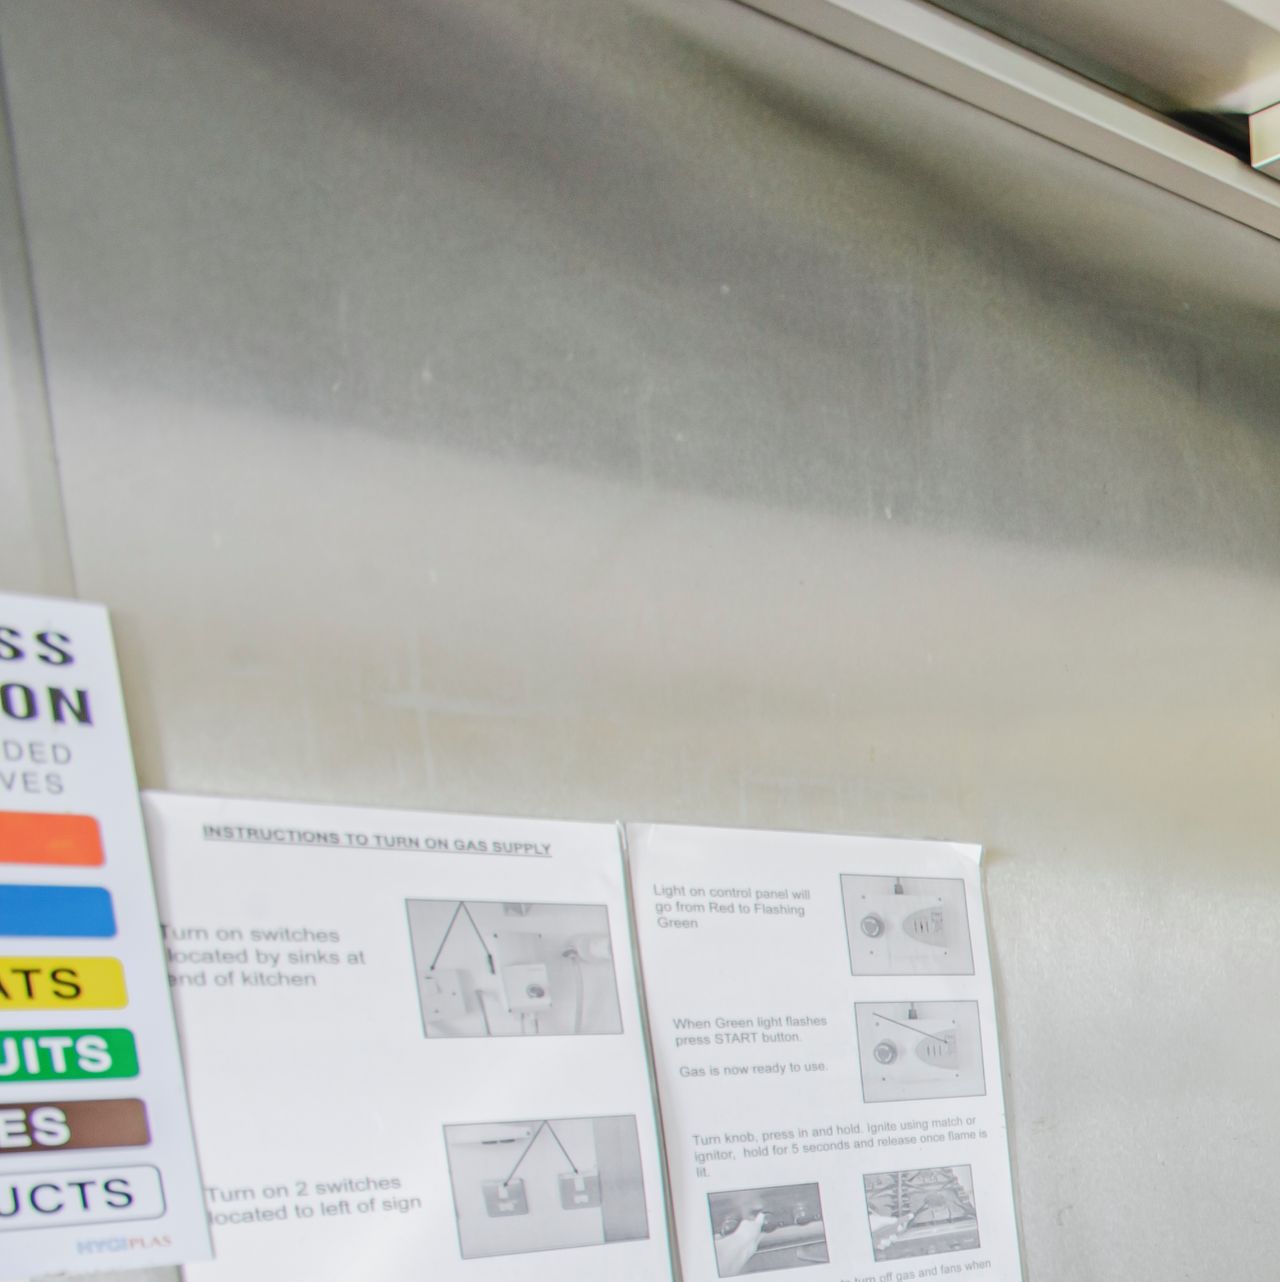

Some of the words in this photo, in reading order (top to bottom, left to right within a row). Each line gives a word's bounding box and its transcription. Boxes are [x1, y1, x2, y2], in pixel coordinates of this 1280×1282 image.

[203, 824, 340, 845] INSTRUCTIONS
[345, 833, 369, 846] TO
[374, 834, 420, 849] TURN
[425, 837, 450, 850] ON
[454, 839, 489, 852] GAS
[493, 841, 552, 856] SUPPLY
[652, 884, 686, 899] Light
[688, 887, 706, 897] on
[708, 887, 752, 898] control
[754, 888, 789, 900] panel
[791, 888, 811, 900] will
[654, 902, 672, 915] go
[675, 900, 705, 912] from
[708, 900, 735, 914] Red
[737, 902, 751, 914] to
[753, 902, 805, 917] Flashing
[656, 916, 699, 928] Green
[215, 927, 244, 941] on
[249, 927, 340, 943] switches
[254, 948, 280, 968] by
[287, 949, 340, 964] sinks
[346, 950, 365, 965] at
[0, 968, 82, 1000] TS
[168, 969, 206, 989] end
[213, 969, 235, 986] of
[240, 970, 317, 986] kitchen
[672, 1017, 711, 1029] When
[714, 1016, 754, 1029] Green
[756, 1015, 782, 1030] light
[785, 1015, 827, 1027] flashes
[674, 1035, 711, 1047] press
[714, 1031, 758, 1044] START
[678, 1065, 706, 1078] Gas
[708, 1064, 720, 1076] is
[723, 1065, 749, 1075] now
[751, 1062, 786, 1075] ready
[788, 1061, 801, 1072] to
[803, 1062, 829, 1072] use.
[692, 1133, 721, 1146] Turn
[761, 1129, 795, 1142] press
[797, 1127, 809, 1138] in
[811, 1125, 833, 1137] and
[866, 1121, 897, 1135] Ignite
[899, 1119, 929, 1131] using
[931, 1115, 963, 1128] match
[965, 1116, 976, 1126] or
[693, 1149, 736, 1164] ignitor,
[742, 1145, 769, 1158] hold
[771, 1144, 788, 1155] for
[790, 1142, 799, 1154] 5
[802, 1139, 850, 1153] seconds
[853, 1137, 874, 1149] and
[876, 1135, 917, 1146] release
[919, 1133, 946, 1143] once
[947, 1130, 976, 1141] flame
[978, 1127, 988, 1139] is
[206, 1187, 256, 1203] Turn
[261, 1185, 289, 1199] on
[295, 1180, 308, 1197] 2
[315, 1177, 402, 1194] switches
[208, 1205, 288, 1226] located
[293, 1203, 314, 1218] to
[319, 1199, 351, 1216] left
[356, 1196, 376, 1213] of
[381, 1196, 422, 1213] sign
[918, 1264, 938, 1278] and
[939, 1263, 962, 1274] fans
[964, 1259, 992, 1271] when
